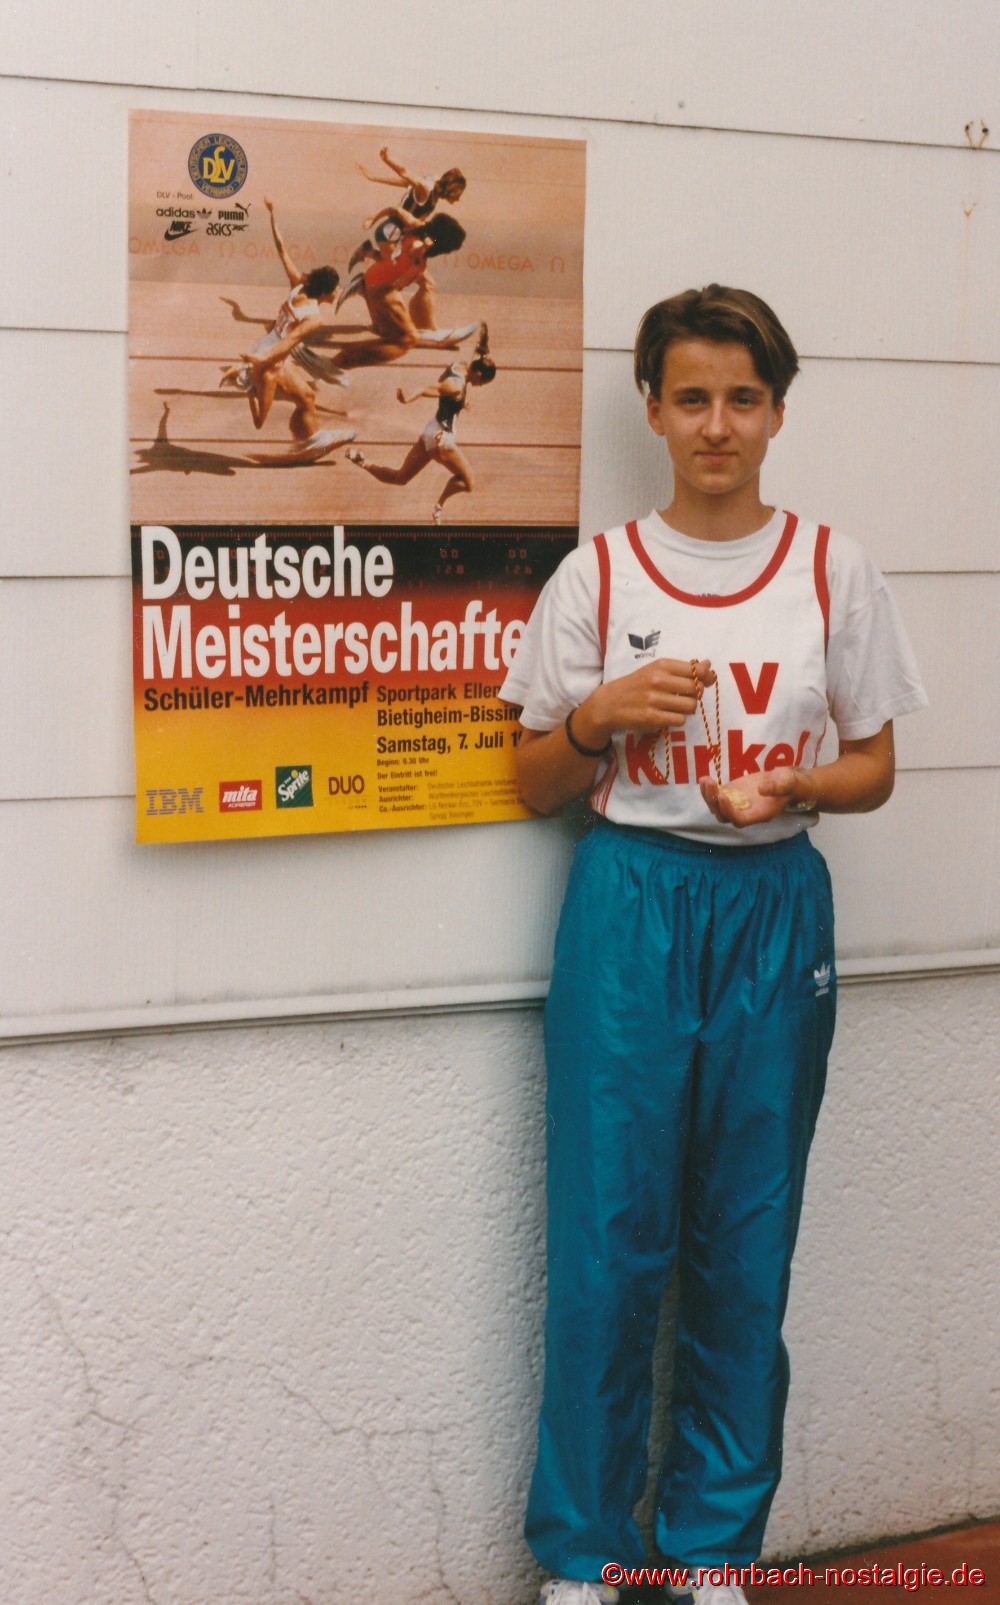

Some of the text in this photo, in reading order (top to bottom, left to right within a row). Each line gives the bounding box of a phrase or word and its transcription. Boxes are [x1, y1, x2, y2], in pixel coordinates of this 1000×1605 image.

[156, 207, 195, 219] adidas
[218, 210, 244, 220] PUMA
[169, 221, 193, 232] NIKE
[206, 222, 232, 236] asics
[467, 252, 534, 273] OMEGA
[141, 526, 393, 599] Deutsche
[143, 600, 528, 680] Meisterschafte
[144, 681, 369, 711] Schüler-Mehrkampf
[377, 683, 457, 705] Sportpark
[729, 662, 780, 714] V
[377, 705, 523, 729] Bietigheim-Bissin
[377, 734, 451, 754] Samstag,
[458, 733, 468, 749] 7.
[475, 731, 504, 749] Juli
[377, 759, 400, 767] Beginn:
[278, 769, 310, 801] Sprite
[328, 775, 365, 796] DUO
[378, 772, 388, 780] Der
[146, 787, 204, 816] IBM
[222, 785, 258, 803] mita
